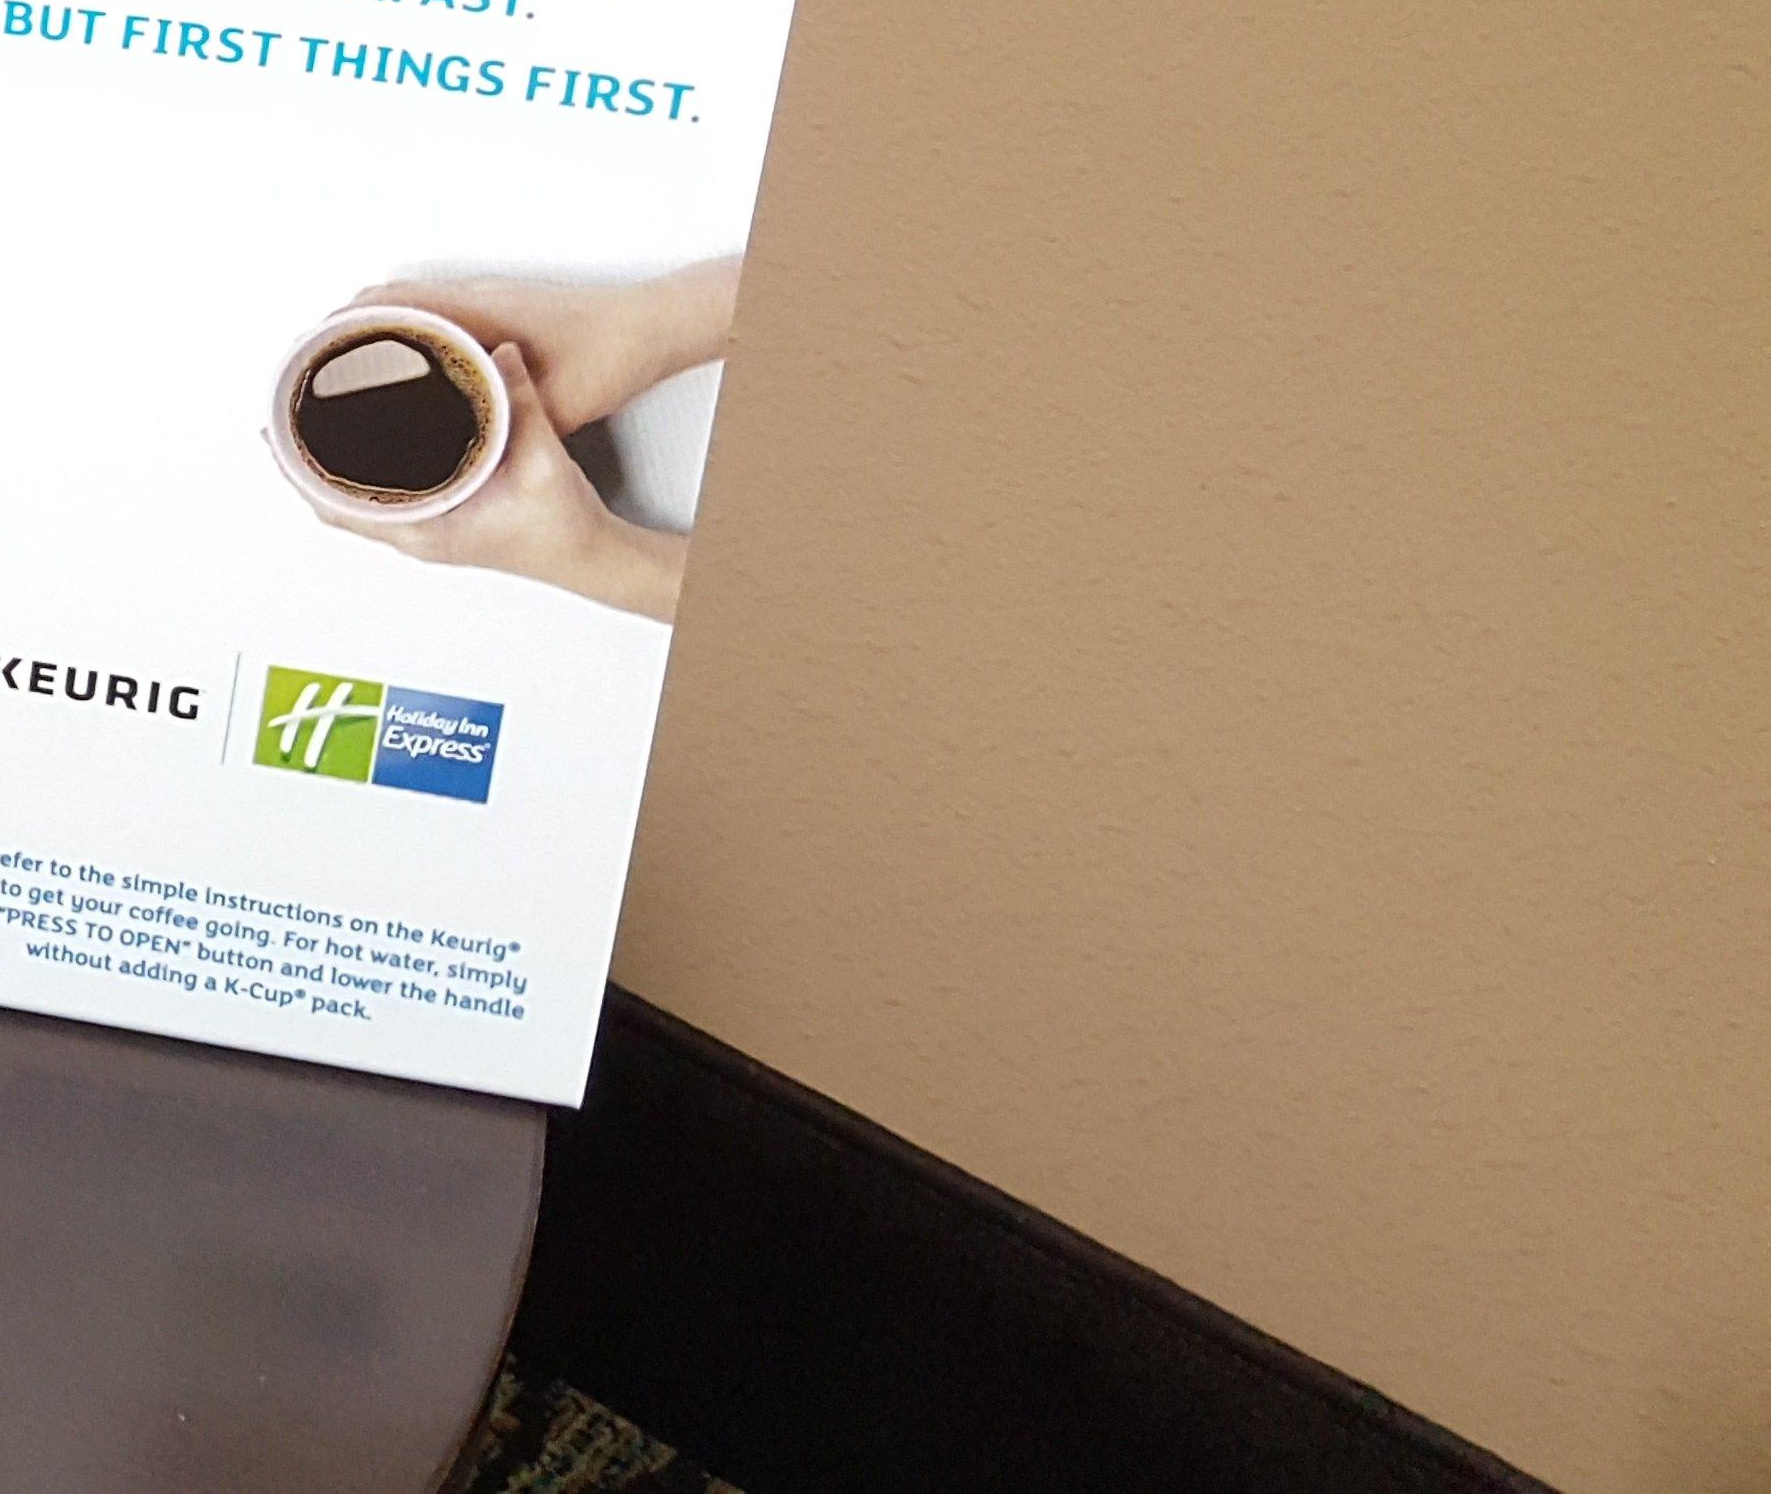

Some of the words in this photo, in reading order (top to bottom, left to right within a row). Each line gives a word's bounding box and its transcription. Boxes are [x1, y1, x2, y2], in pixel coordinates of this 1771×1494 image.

[3, 0, 106, 45] BUT
[121, 15, 282, 68] FIRST
[298, 36, 505, 97] THINGS
[525, 65, 700, 123] FIRST.
[386, 705, 458, 736] Holiday
[459, 717, 489, 738] Inn
[1, 878, 22, 897] to
[28, 885, 64, 906] get
[71, 893, 123, 916] your
[129, 904, 198, 930] coffee
[205, 919, 276, 948] going.
[283, 931, 319, 954] For
[325, 937, 364, 962] hot
[370, 947, 439, 977] water,
[447, 961, 528, 995] simply
[51, 859, 72, 878] to
[79, 865, 115, 887] the
[122, 873, 198, 904] simple
[205, 887, 344, 929] instructions
[350, 918, 379, 936] on
[386, 920, 424, 943] the
[26, 941, 111, 971] without
[119, 955, 197, 991] adding
[204, 976, 217, 991] a
[312, 994, 372, 1020] pack.
[86, 922, 113, 942] TO
[120, 929, 192, 955] OPEN"
[197, 941, 273, 973] button
[280, 961, 324, 983] and
[331, 967, 393, 995] lower
[399, 980, 437, 1004] the
[444, 989, 525, 1020] handle
